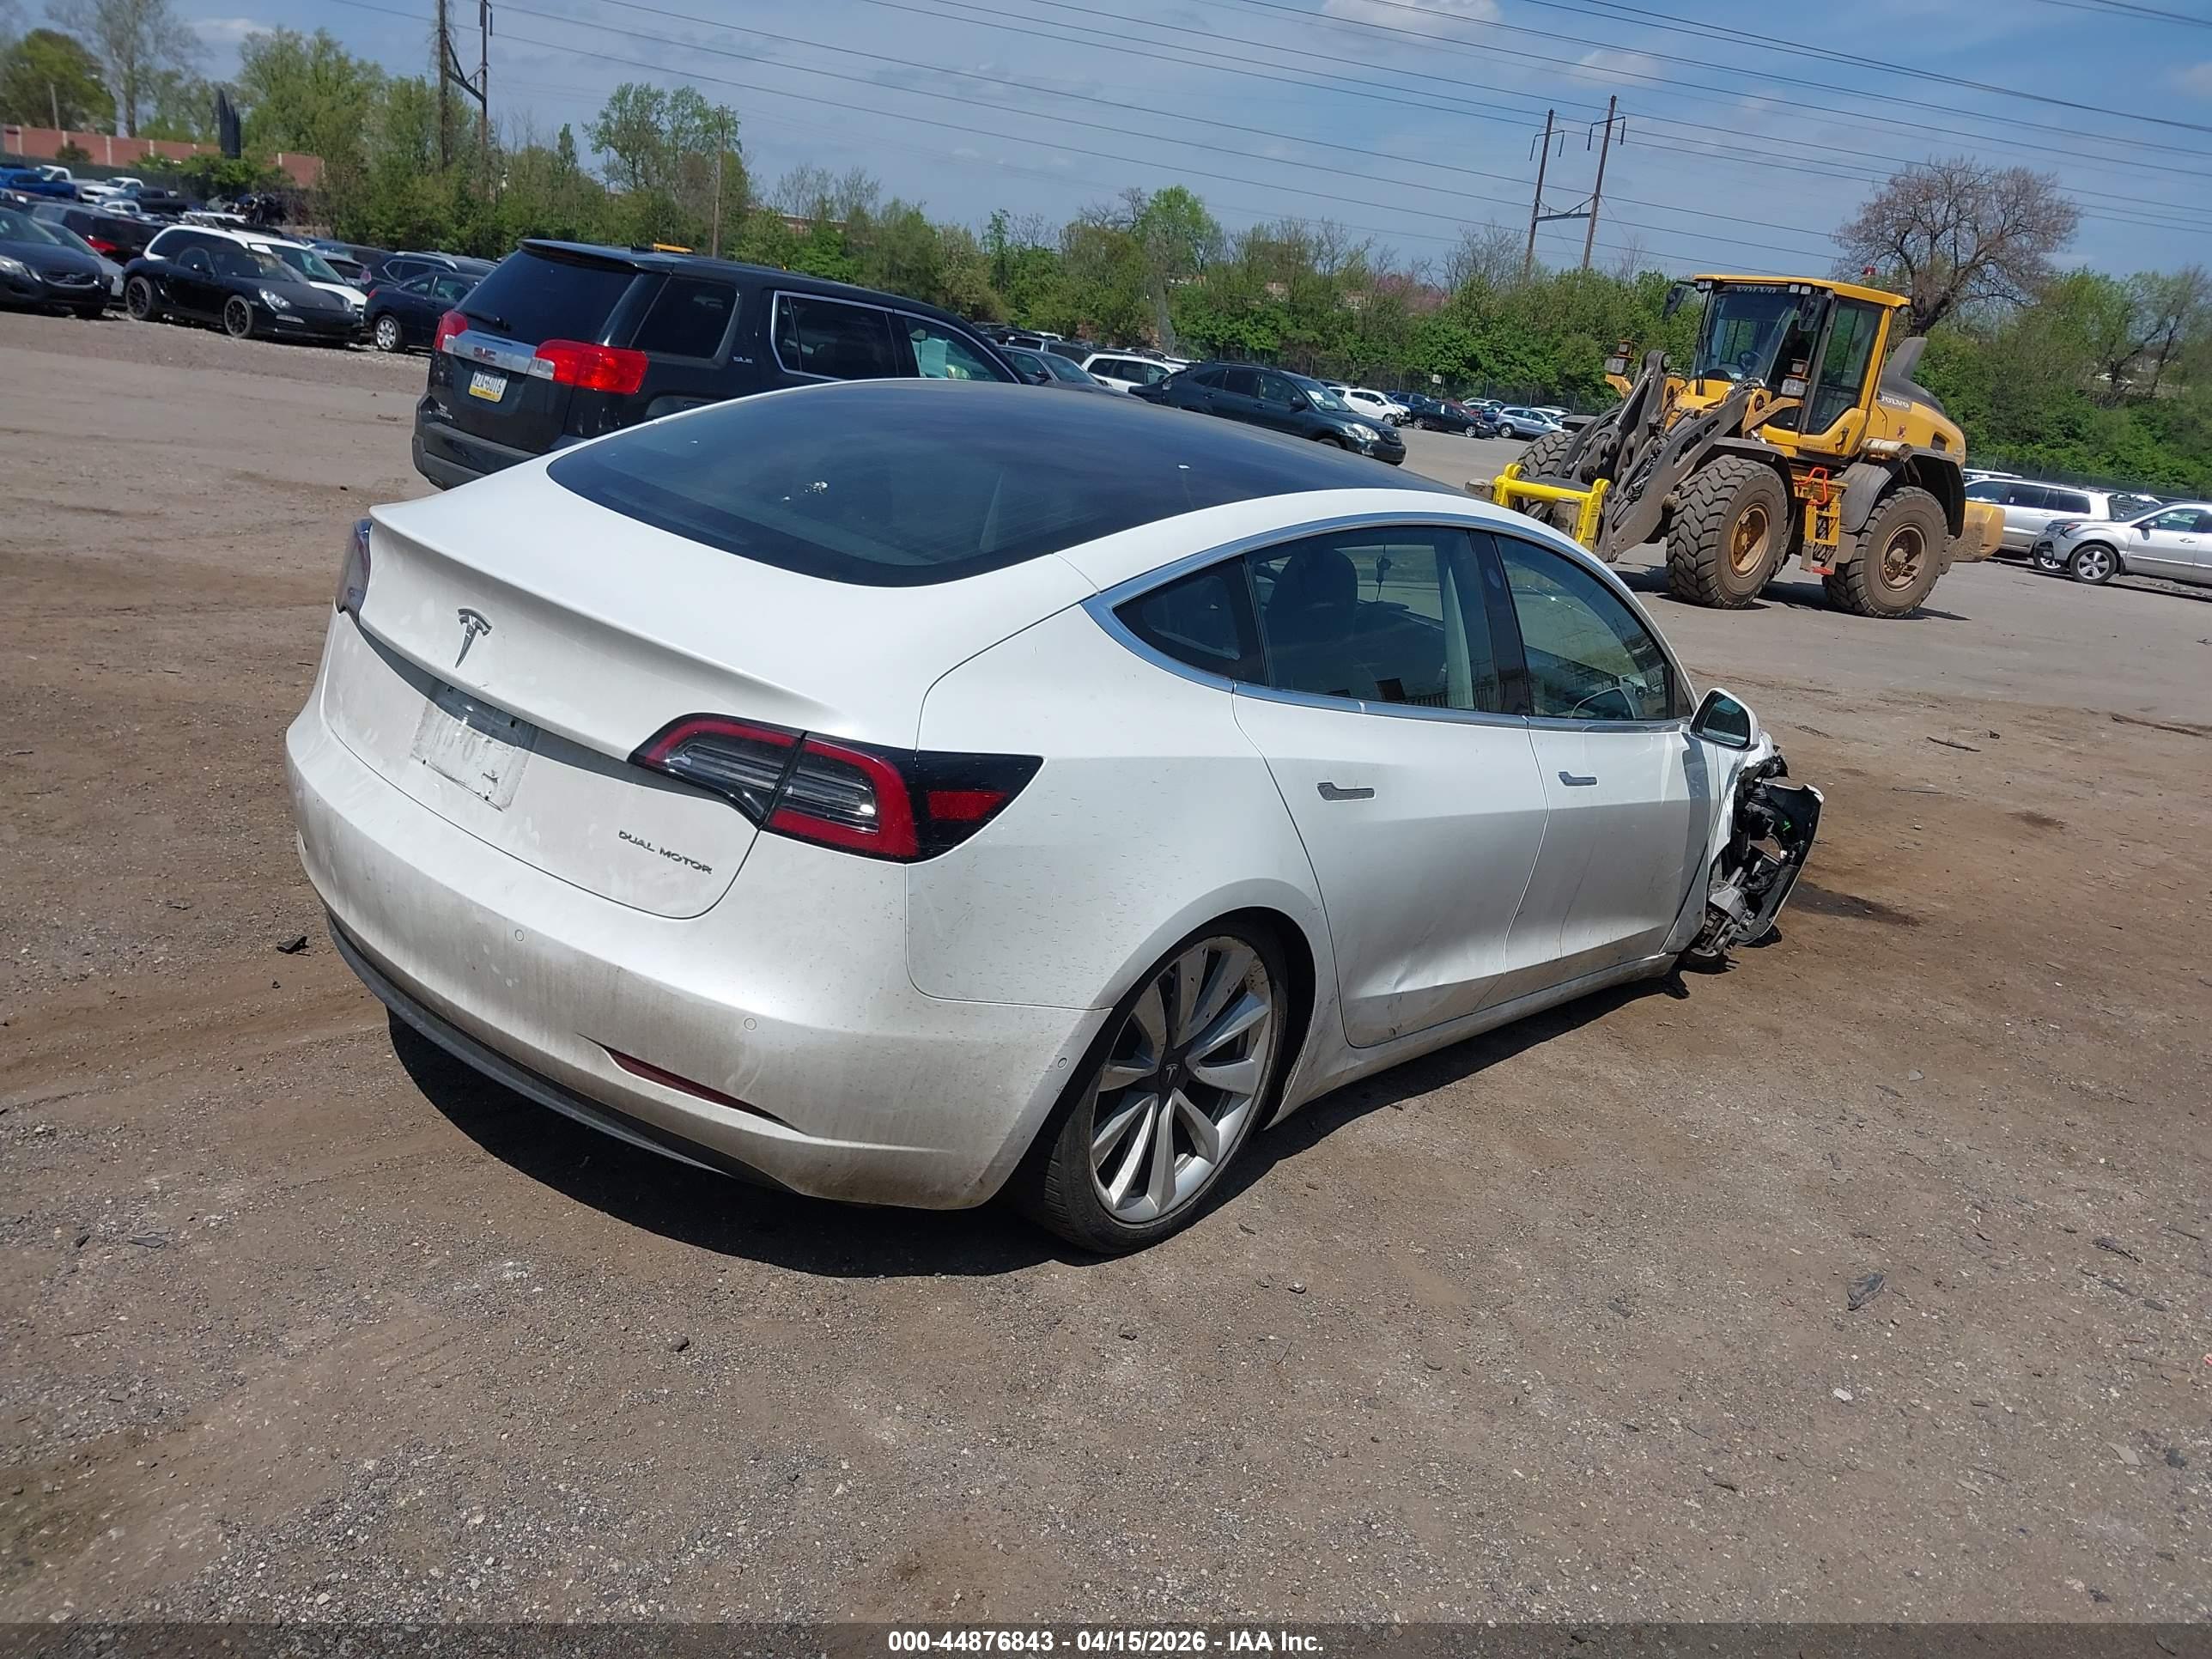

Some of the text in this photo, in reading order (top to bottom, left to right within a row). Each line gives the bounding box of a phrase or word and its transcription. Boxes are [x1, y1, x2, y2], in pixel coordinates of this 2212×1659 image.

[1736, 285, 1778, 295] VOLVO
[618, 830, 714, 874] DUAL MOTOR
